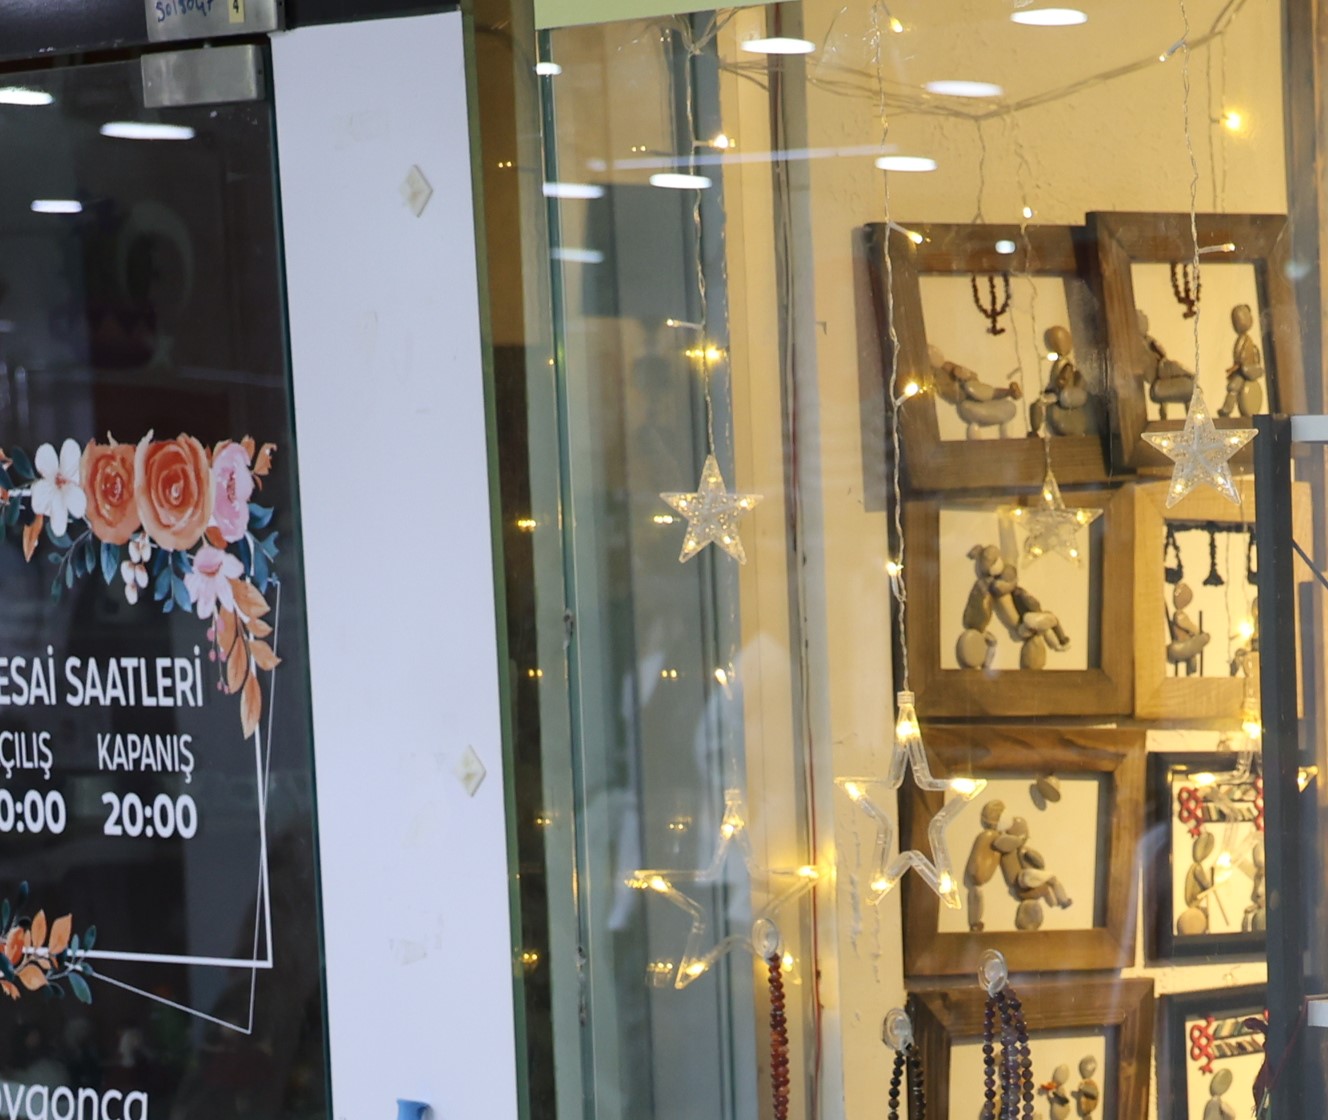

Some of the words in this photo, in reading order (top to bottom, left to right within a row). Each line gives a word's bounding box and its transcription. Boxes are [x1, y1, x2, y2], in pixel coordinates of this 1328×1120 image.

[65, 645, 203, 707] SAATLERİ
[0, 731, 53, 780] ÇILIŞ
[97, 733, 194, 784] KAPANIŞ
[101, 792, 198, 839] 20:00
